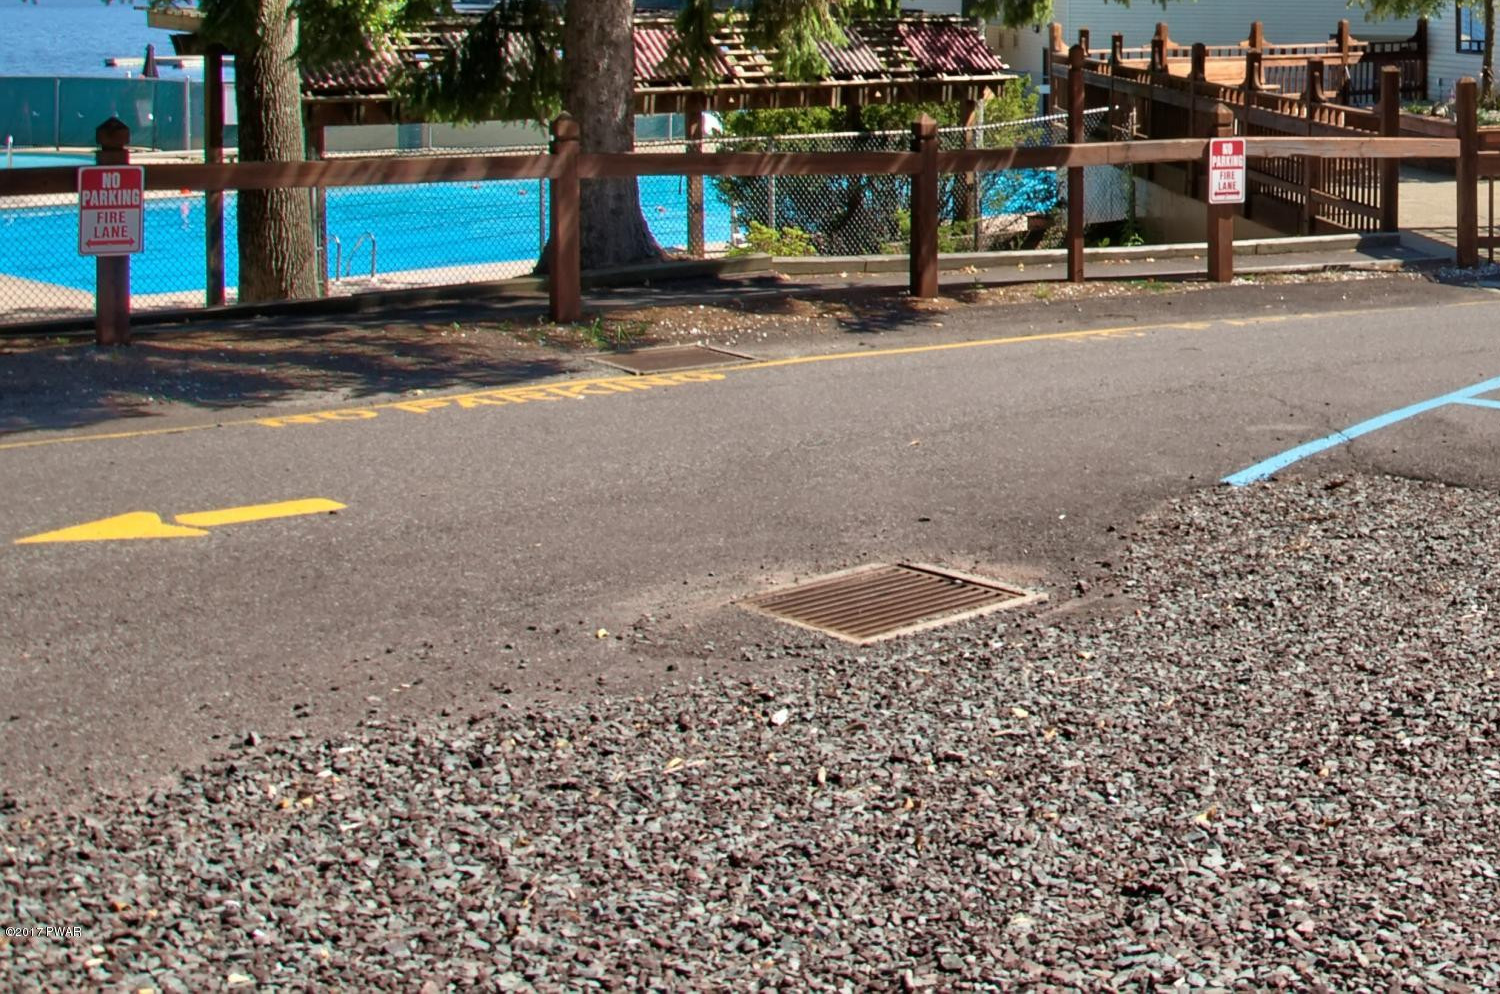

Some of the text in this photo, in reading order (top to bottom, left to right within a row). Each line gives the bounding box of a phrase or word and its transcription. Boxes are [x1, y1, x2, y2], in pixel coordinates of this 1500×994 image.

[1222, 142, 1233, 155] NO
[1212, 154, 1244, 167] PARKING
[102, 172, 120, 189] NO
[1219, 170, 1235, 180] FIRE
[1218, 180, 1237, 191] LANE
[82, 189, 140, 207] PARKING
[97, 211, 126, 224] FIRE
[94, 225, 128, 238] LANE
[394, 373, 726, 413] PARKING
